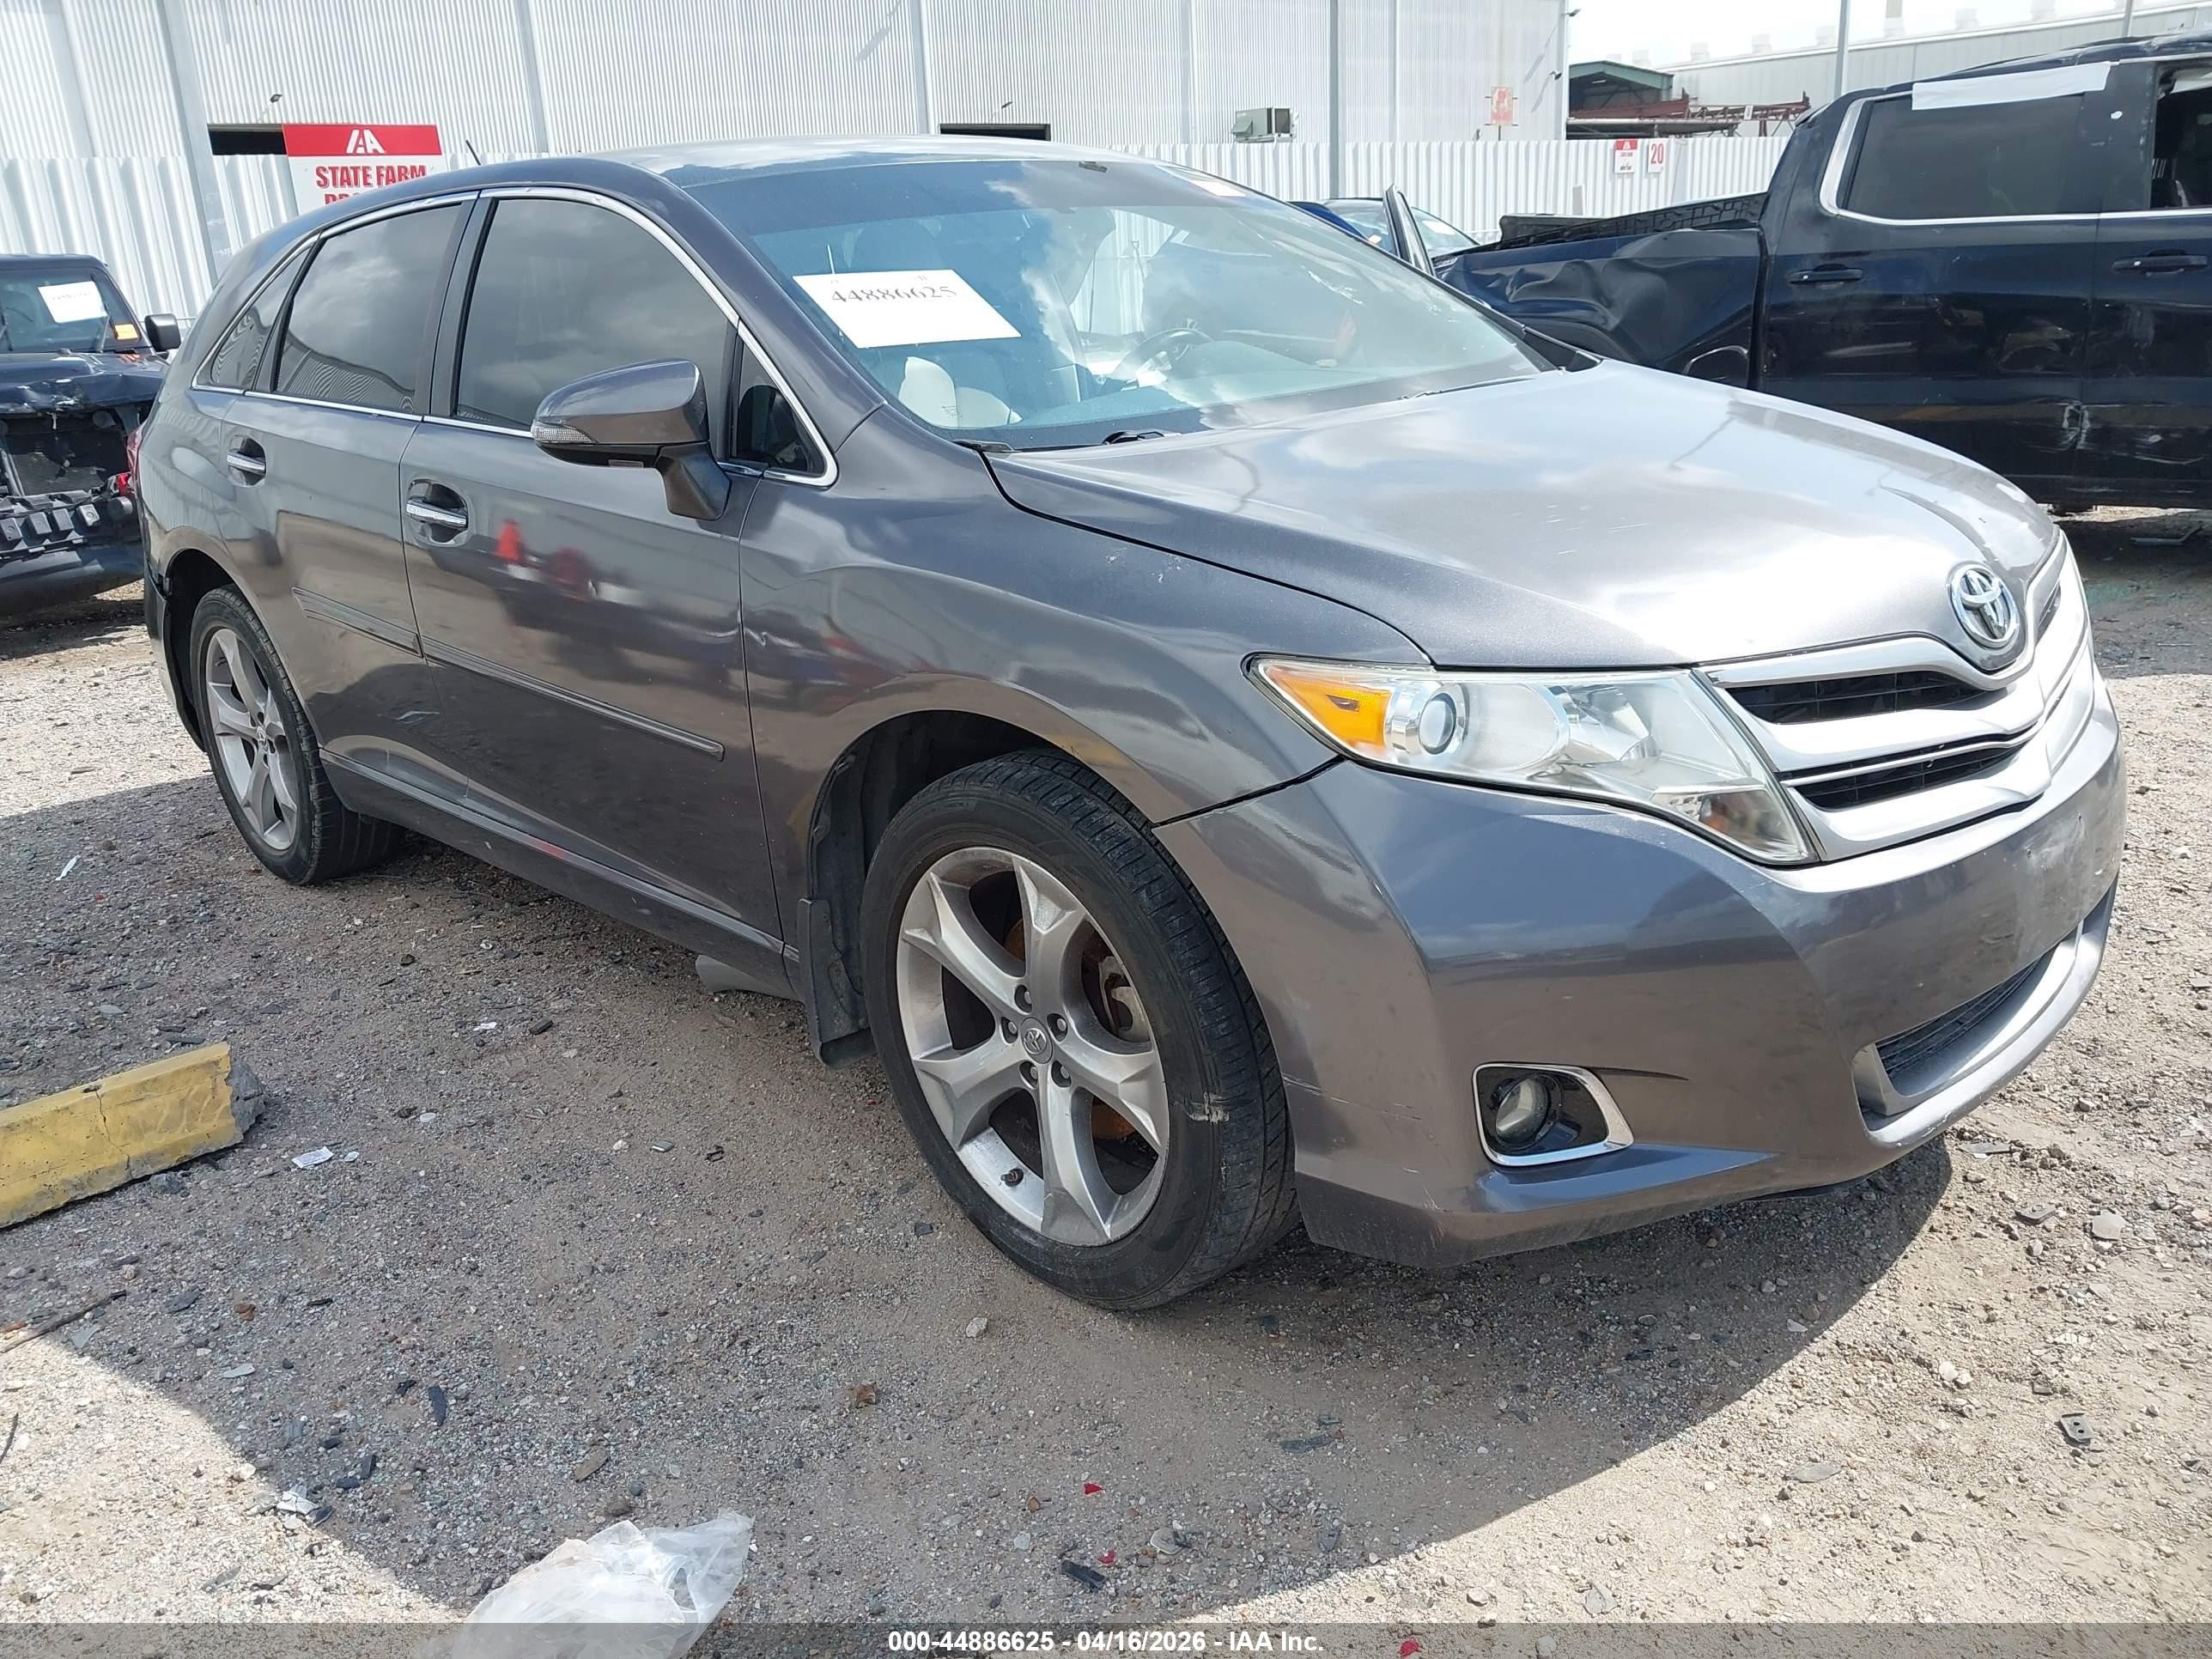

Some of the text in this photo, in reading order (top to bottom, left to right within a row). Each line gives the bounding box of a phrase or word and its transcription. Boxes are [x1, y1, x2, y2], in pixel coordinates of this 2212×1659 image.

[1650, 143, 1664, 164] 20
[315, 165, 372, 187] STATE
[831, 286, 957, 302] 44886625
